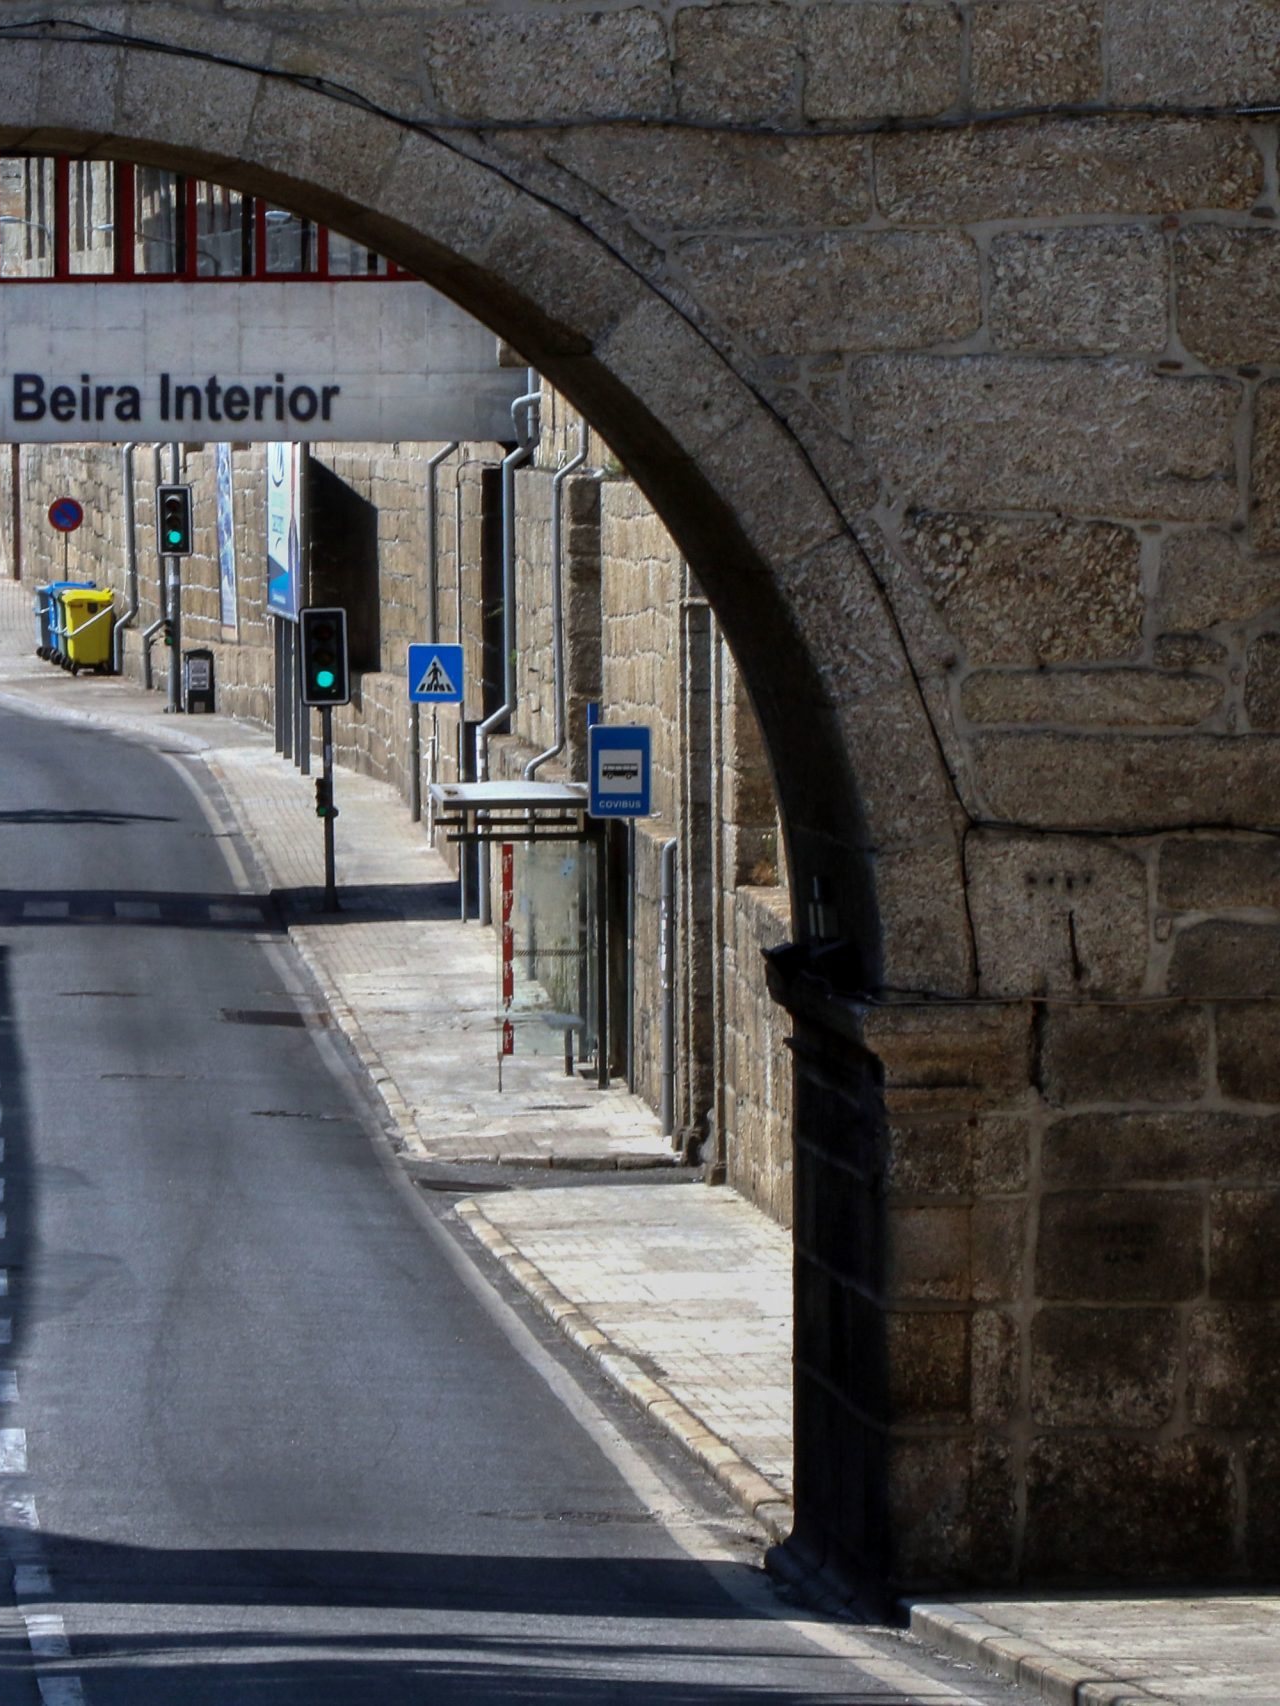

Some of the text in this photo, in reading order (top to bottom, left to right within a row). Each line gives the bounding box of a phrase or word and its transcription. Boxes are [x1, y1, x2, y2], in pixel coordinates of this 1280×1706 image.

[13, 373, 141, 422] Beira
[160, 373, 340, 422] Interior
[598, 800, 642, 809] COVIBUS
